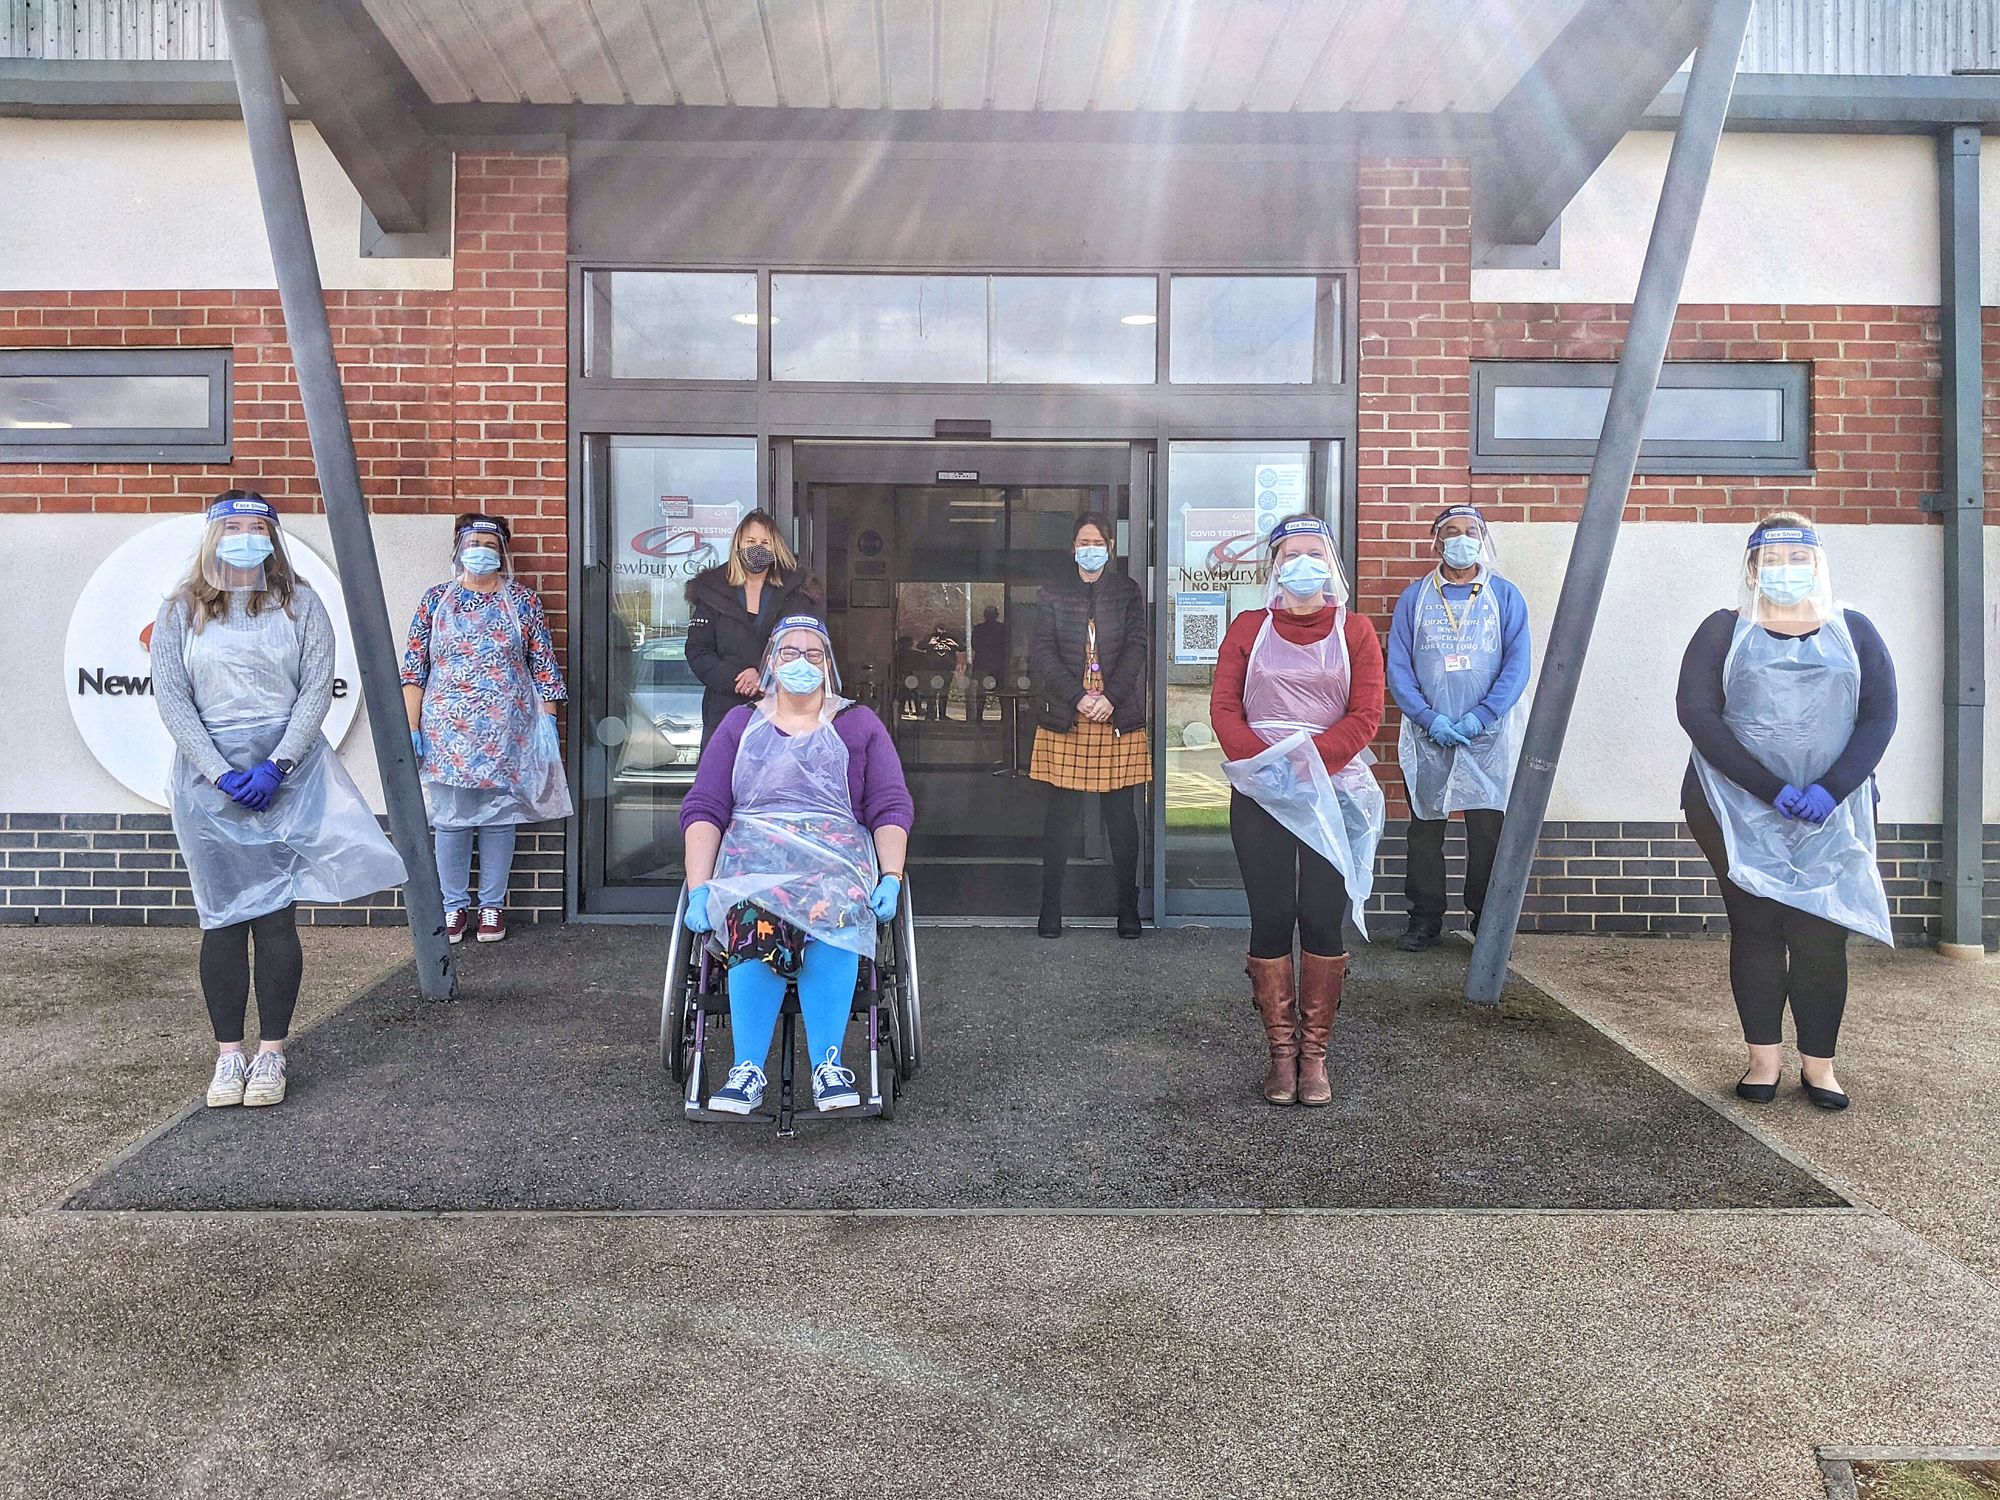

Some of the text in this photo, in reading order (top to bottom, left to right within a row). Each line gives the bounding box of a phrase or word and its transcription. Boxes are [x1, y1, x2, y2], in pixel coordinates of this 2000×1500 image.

[672, 526, 733, 534] COVID TESTING
[1766, 530, 1781, 538] Face
[1782, 530, 1801, 538] Shield
[598, 558, 716, 579] Newbury Coll
[1179, 565, 1258, 585] Newbury
[1192, 582, 1209, 592] NO
